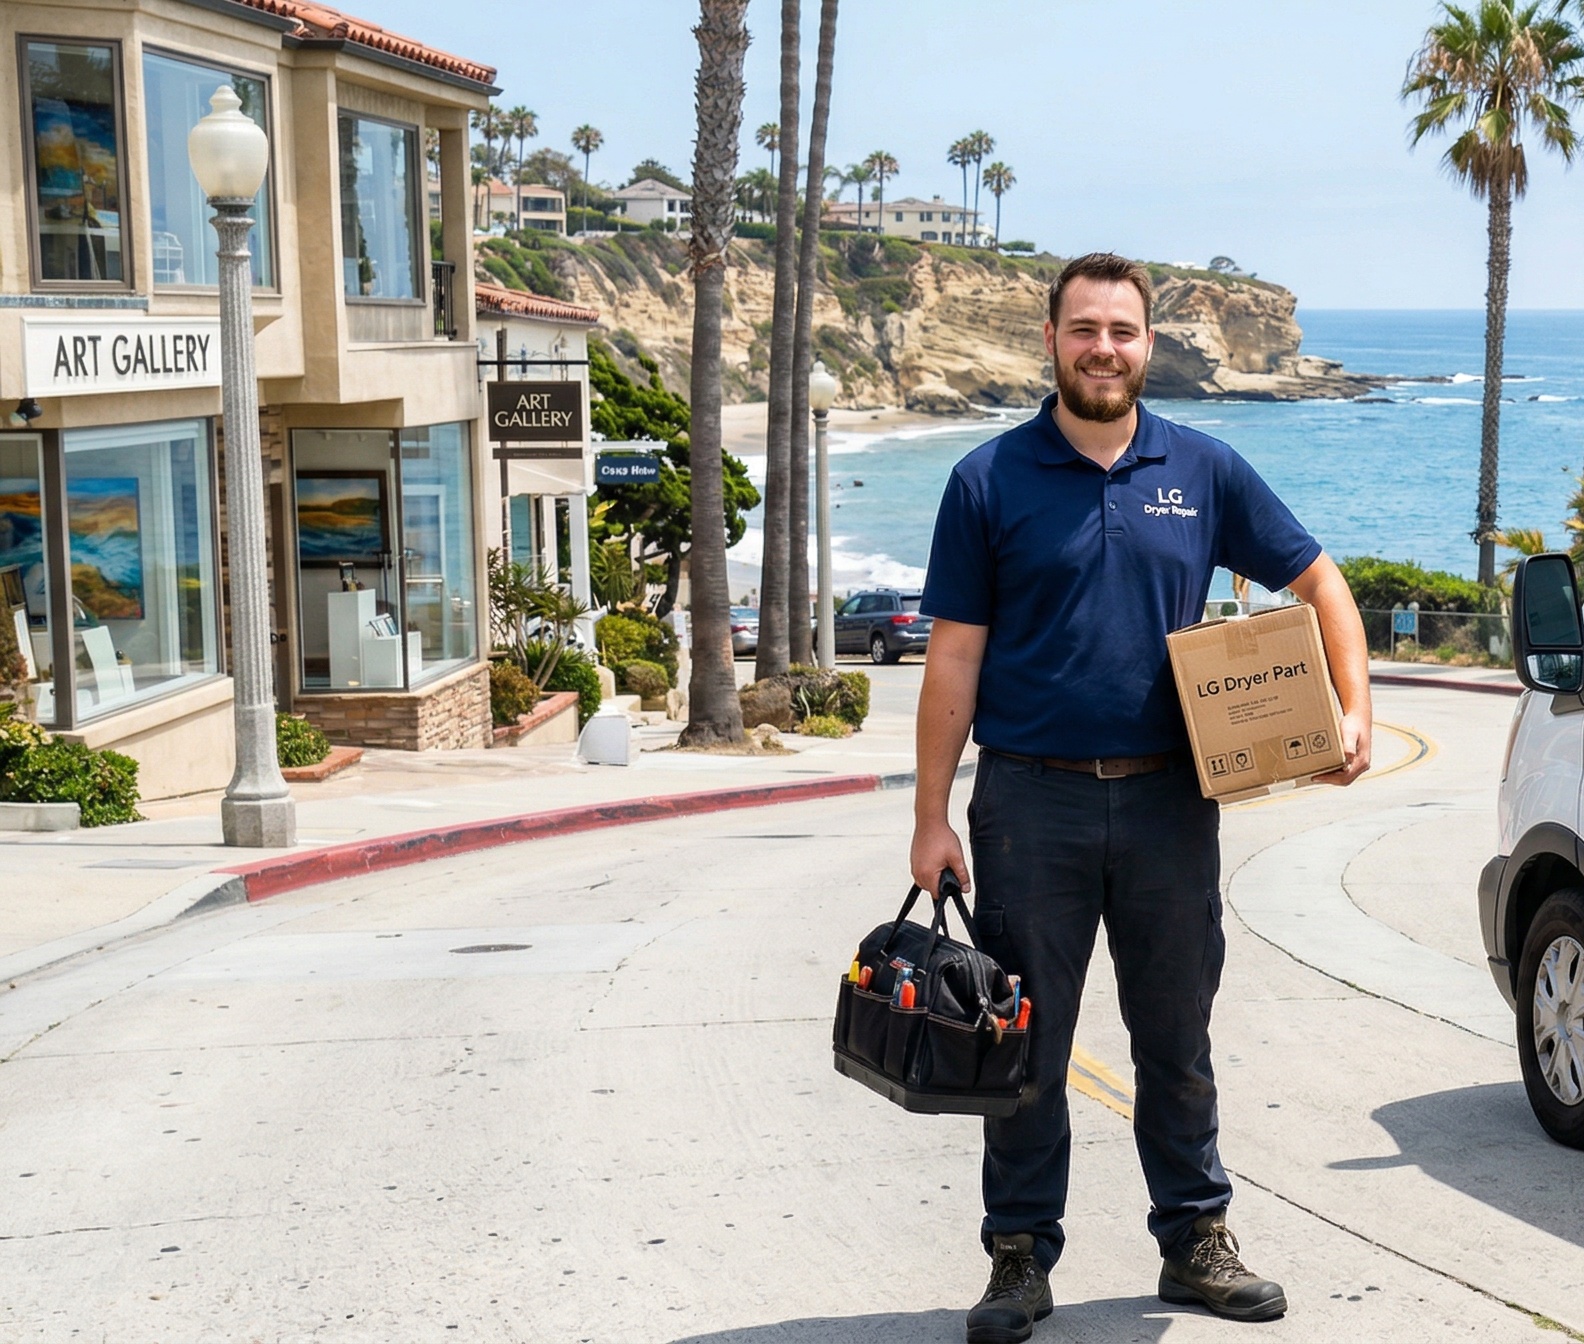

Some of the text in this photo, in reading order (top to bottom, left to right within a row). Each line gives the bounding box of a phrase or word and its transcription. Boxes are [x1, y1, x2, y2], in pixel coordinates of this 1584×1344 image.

[54, 334, 210, 377] ART GALLERY
[516, 393, 551, 410] ART
[494, 411, 573, 427] GALLERY
[1157, 487, 1183, 505] LG
[1144, 504, 1170, 517] Dryer
[1197, 661, 1308, 698] LG Dryer Part
